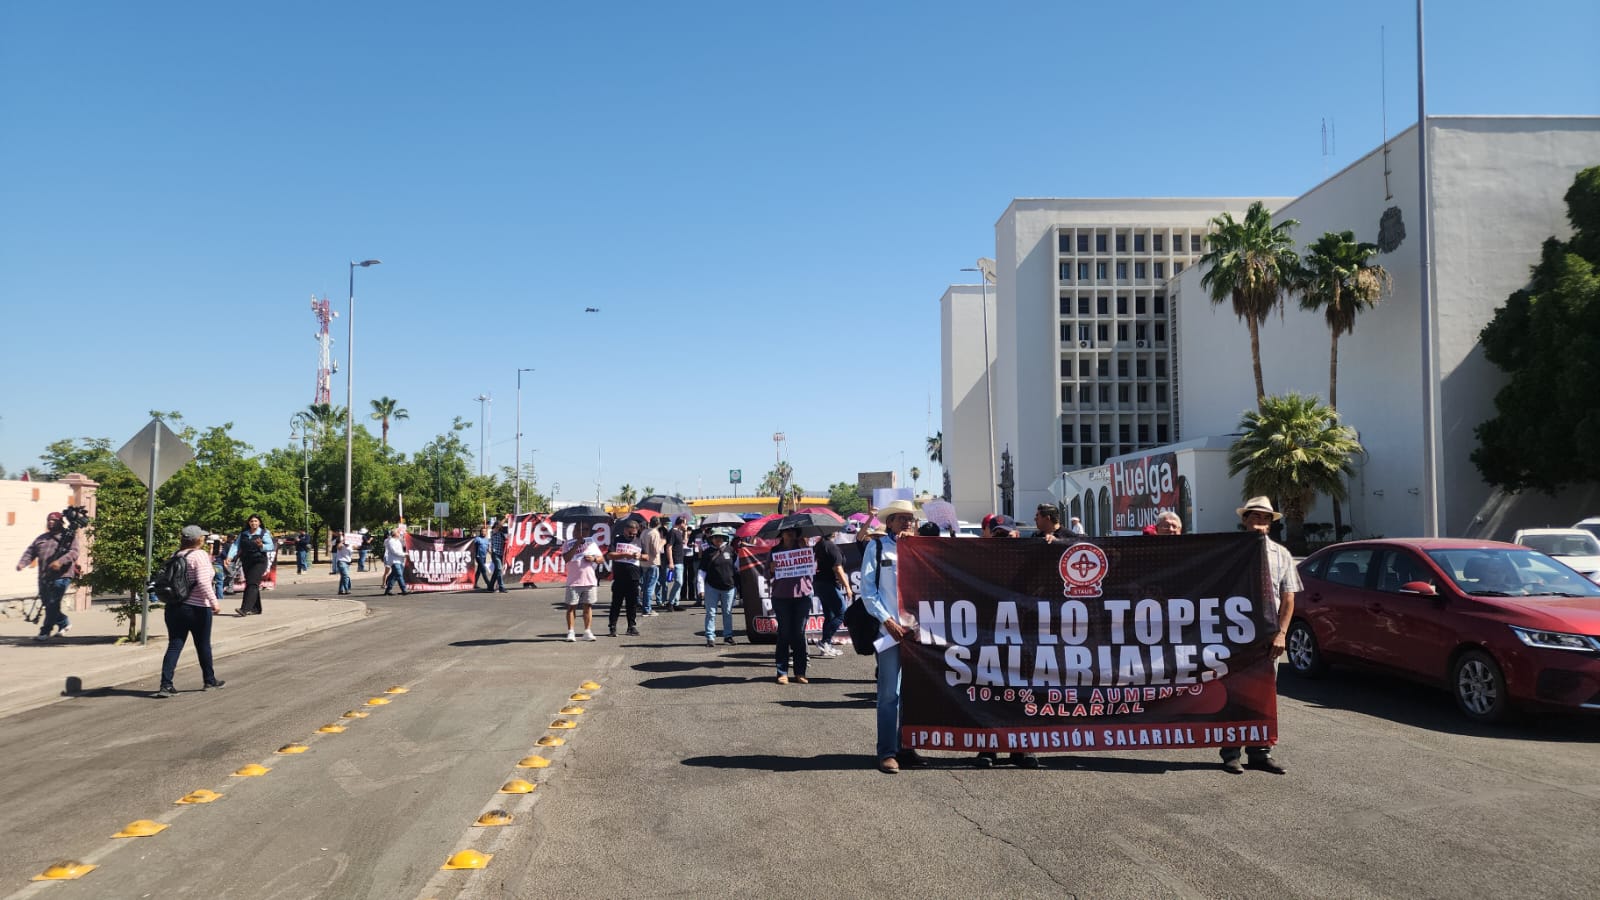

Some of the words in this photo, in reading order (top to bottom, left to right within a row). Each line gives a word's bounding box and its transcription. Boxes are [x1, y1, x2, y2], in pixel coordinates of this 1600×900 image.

[1113, 456, 1174, 504] Huelga
[1115, 512, 1125, 528] en
[1127, 508, 1135, 528] la
[422, 550, 428, 563] A
[430, 550, 441, 563] LO
[510, 557, 524, 575] la
[775, 556, 813, 568] CALLADOS
[918, 599, 978, 646] NO
[994, 601, 1024, 645] A
[1037, 599, 1089, 646] LO
[1103, 596, 1256, 645] TOPES
[944, 644, 1231, 687] SALARIALES
[966, 686, 1035, 703] 10.8%
[1048, 688, 1078, 704] DE
[1089, 683, 1204, 704] AUMENTO
[1024, 702, 1145, 717] SALARIAL
[911, 731, 954, 747] ¡POR
[963, 732, 999, 748] UNA
[1008, 728, 1096, 748] REVISIÓN
[1103, 728, 1196, 746] SALARIAL
[1204, 725, 1268, 744] JUSTA!
